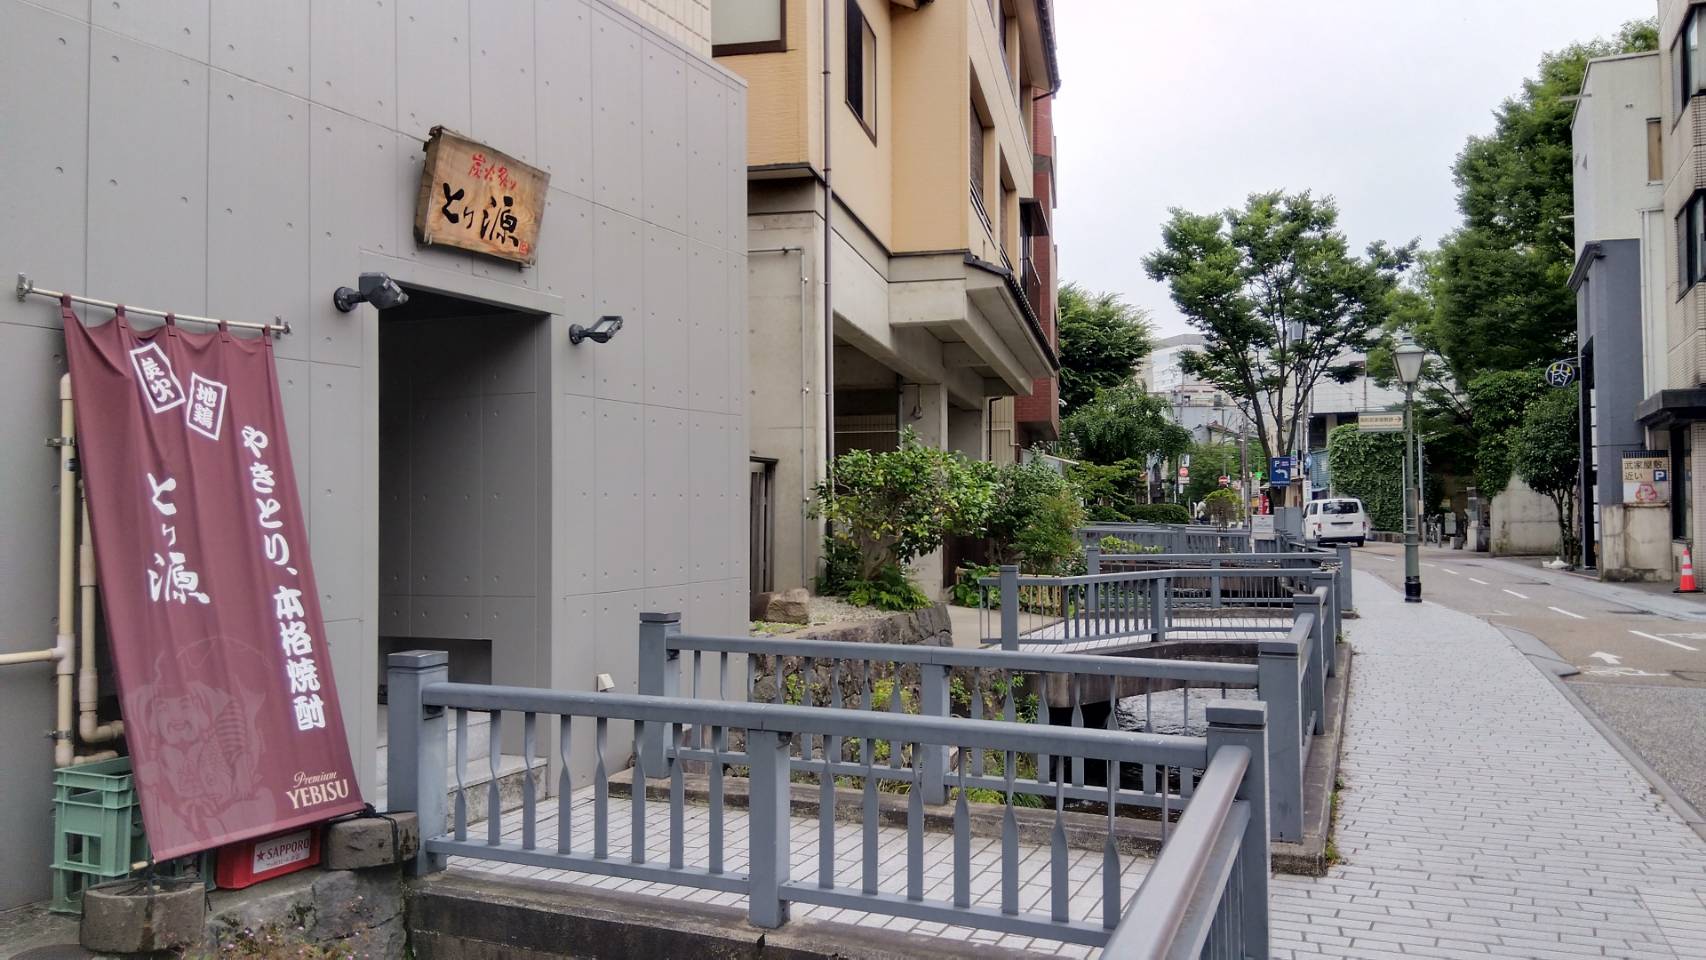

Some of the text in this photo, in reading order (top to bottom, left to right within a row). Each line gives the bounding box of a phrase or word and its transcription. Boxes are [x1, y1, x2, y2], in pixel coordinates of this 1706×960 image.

[193, 383, 218, 429] 地鶏
[1655, 471, 1665, 480] P
[293, 771, 337, 788] Premium
[286, 779, 349, 809] YEBISU
[267, 838, 310, 860] SAPPORO
